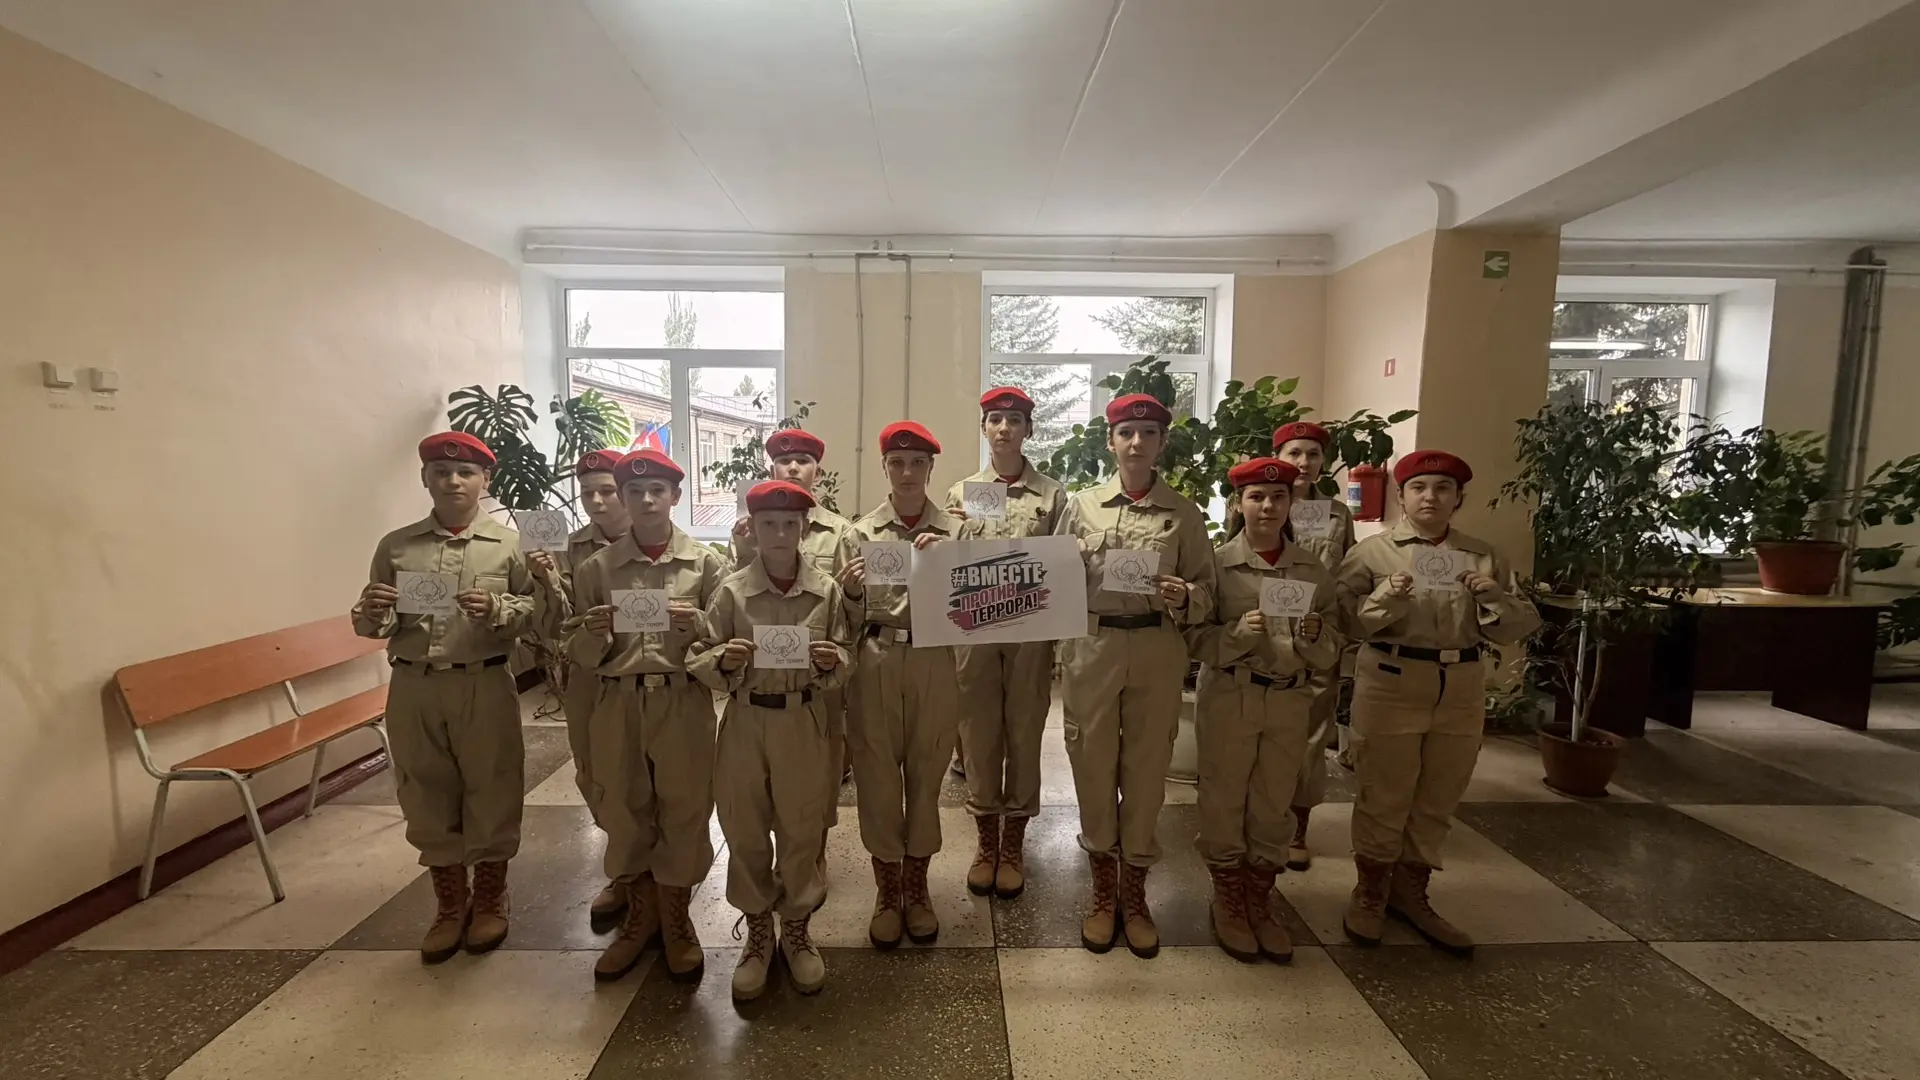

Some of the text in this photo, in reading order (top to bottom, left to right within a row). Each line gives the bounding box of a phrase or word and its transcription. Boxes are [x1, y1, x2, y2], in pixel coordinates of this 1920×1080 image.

[951, 562, 1043, 588] #ВМЕСТЕ
[961, 583, 1017, 612] ПРОТИВ
[970, 592, 1038, 625] ТЕРРОРА!
